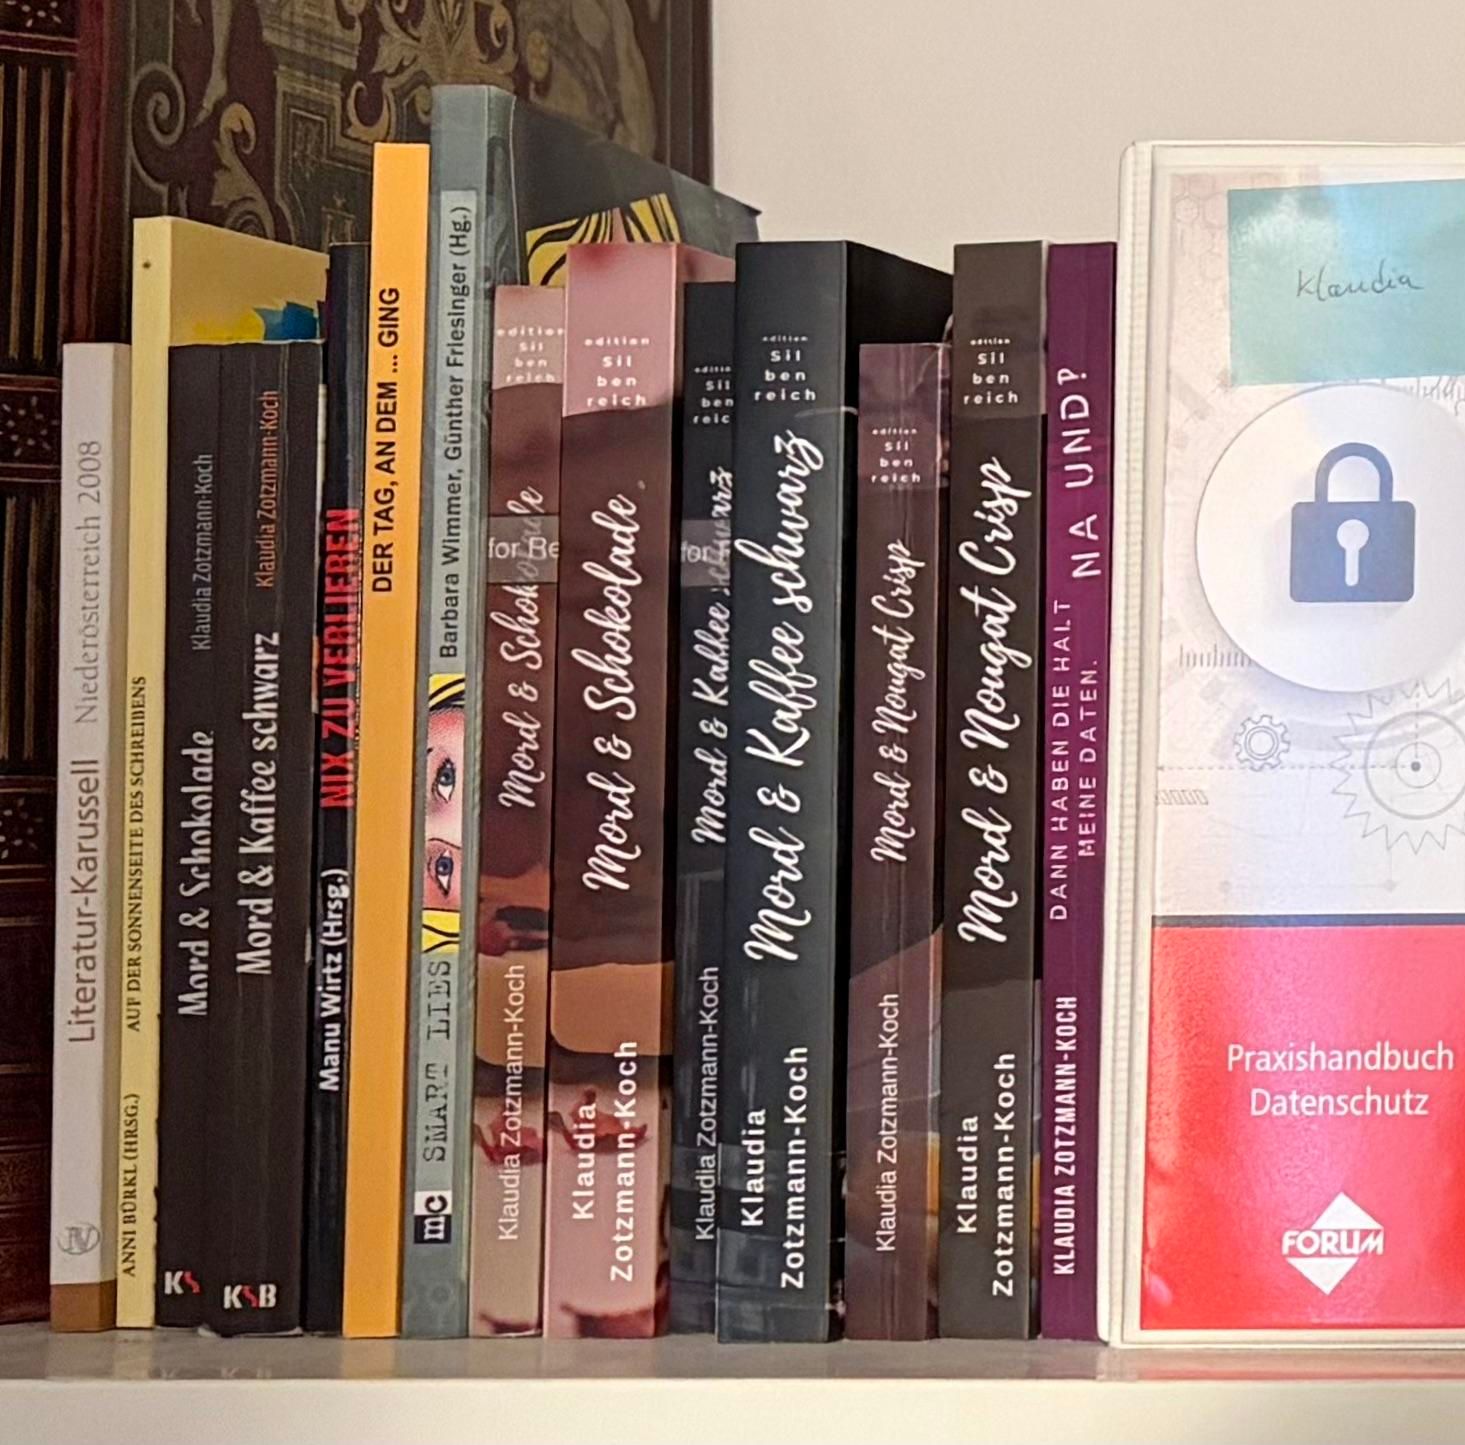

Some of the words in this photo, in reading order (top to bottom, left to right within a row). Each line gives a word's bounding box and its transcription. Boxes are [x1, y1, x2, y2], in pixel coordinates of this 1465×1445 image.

[449, 206, 472, 257] (Hg.)
[378, 287, 400, 348] GING
[446, 263, 471, 368] Friesinger
[765, 370, 805, 381] ben
[771, 350, 800, 362] Sil
[376, 382, 397, 432] DEM
[444, 375, 465, 461] Günther
[755, 388, 816, 400] reich
[77, 441, 101, 503] 2008
[255, 390, 280, 521] Zotzmann-Koch
[375, 442, 395, 474] AN
[373, 481, 398, 536] TAG,
[441, 467, 464, 566] Wimmer,
[734, 430, 823, 613] schwarz
[959, 457, 1032, 575] Crisp
[255, 525, 275, 589] Klaudia
[372, 543, 393, 592] DER
[74, 517, 100, 723] Niederösterreich
[322, 507, 360, 688] VERLIEREN
[439, 572, 460, 659] Barbara
[571, 494, 642, 720] Schokolade
[242, 632, 279, 750] schwarz
[745, 621, 817, 766] Kaffee
[960, 586, 1032, 748] Nougat
[125, 673, 145, 786] SCHREIBENS
[321, 696, 357, 741] ZU
[594, 734, 631, 759] &
[130, 791, 143, 823] DES
[179, 731, 213, 896] Schokolade
[239, 761, 276, 853] Kaffee
[320, 751, 356, 809] NIX
[757, 784, 800, 813] &
[969, 764, 1007, 793] &
[583, 772, 641, 889] Mord
[68, 757, 100, 1045] Literatur-Karussell
[128, 828, 143, 951] SONNENSEITE
[238, 865, 273, 886] &
[318, 868, 349, 947] (Hrsg.)
[744, 827, 811, 960] Mord
[958, 807, 1018, 942] Mord
[179, 908, 209, 928] &
[236, 898, 273, 974] Mord
[127, 956, 141, 991] DER
[178, 941, 208, 1015] Mord
[317, 951, 343, 1018] Wirtz
[427, 960, 451, 1040] LIES
[126, 998, 141, 1032] AUF
[319, 1022, 341, 1092] Manu
[1227, 1041, 1454, 1072] Praxishandbuch
[425, 1064, 450, 1166] SMART
[1250, 1086, 1429, 1116] Datenschutz
[741, 1110, 765, 1225] Klaudia
[781, 1048, 807, 1288] Zotzmann-Koch
[1281, 1229, 1384, 1256] FORUM
